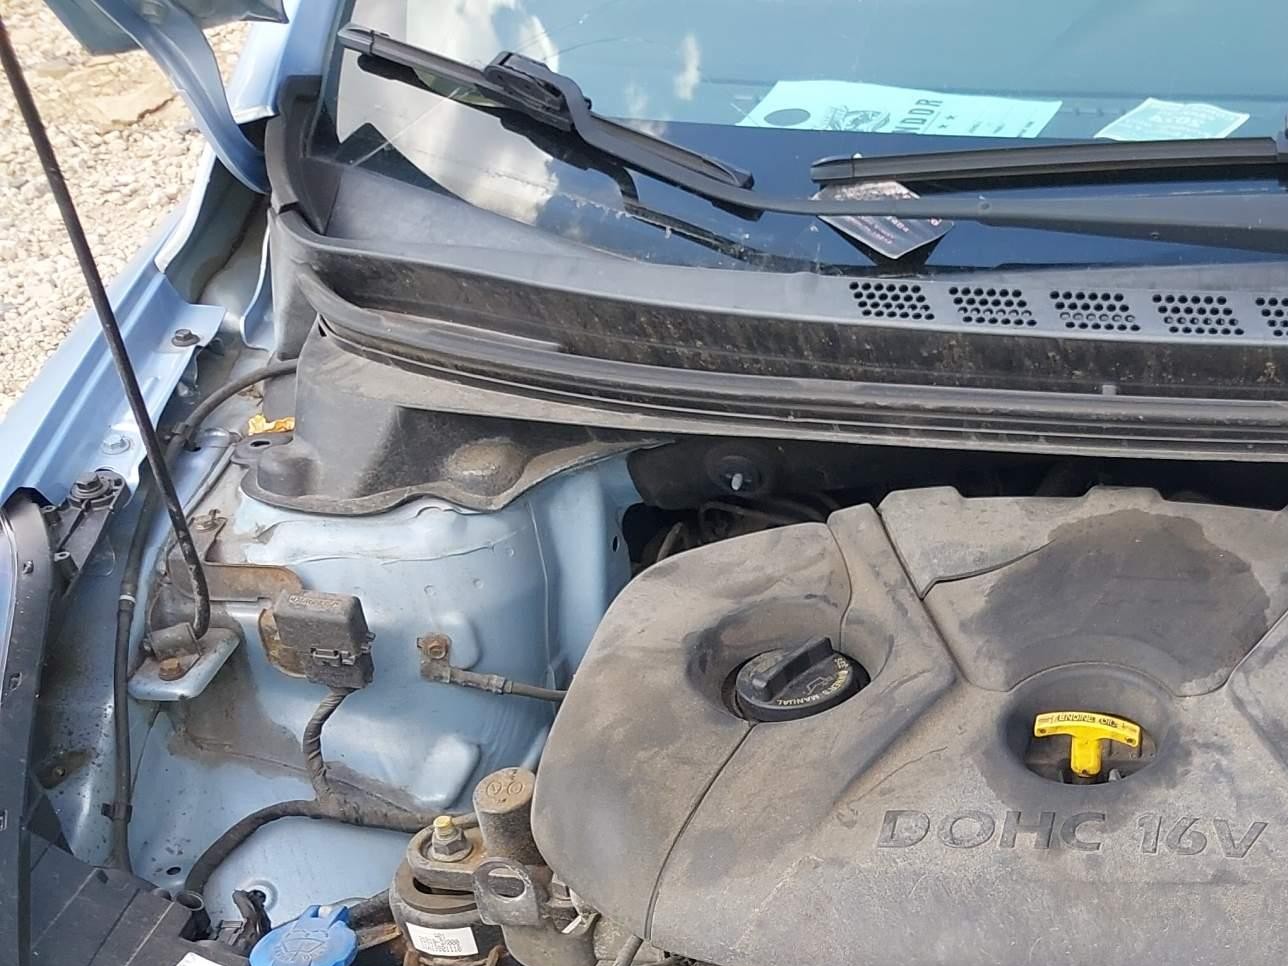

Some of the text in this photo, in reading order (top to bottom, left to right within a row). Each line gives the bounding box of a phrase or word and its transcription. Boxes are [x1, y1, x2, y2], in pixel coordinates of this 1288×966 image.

[776, 694, 820, 705] MANUAL
[1058, 713, 1095, 723] ENGINE
[876, 809, 1269, 860] DOHC 16V
